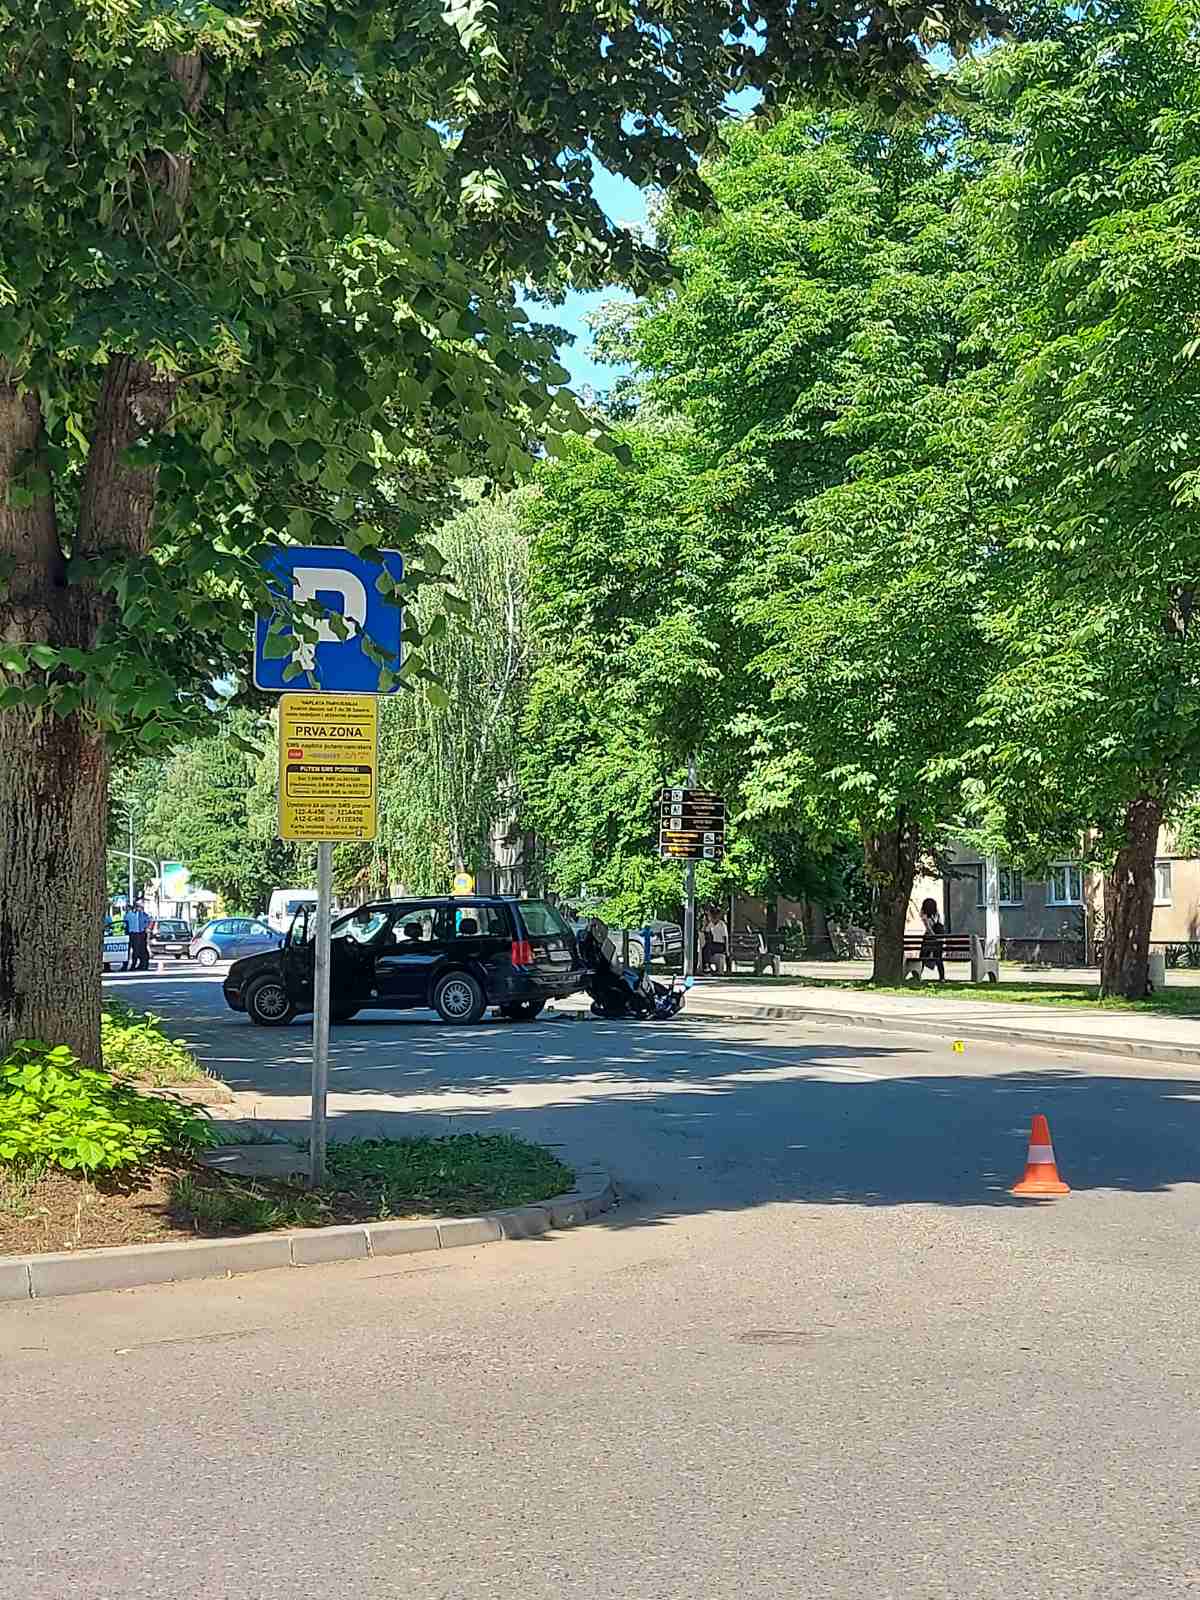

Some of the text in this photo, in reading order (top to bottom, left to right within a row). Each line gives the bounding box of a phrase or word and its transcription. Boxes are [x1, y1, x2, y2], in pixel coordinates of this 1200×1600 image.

[292, 567, 367, 671] P
[295, 726, 363, 737] PRVA ZONA
